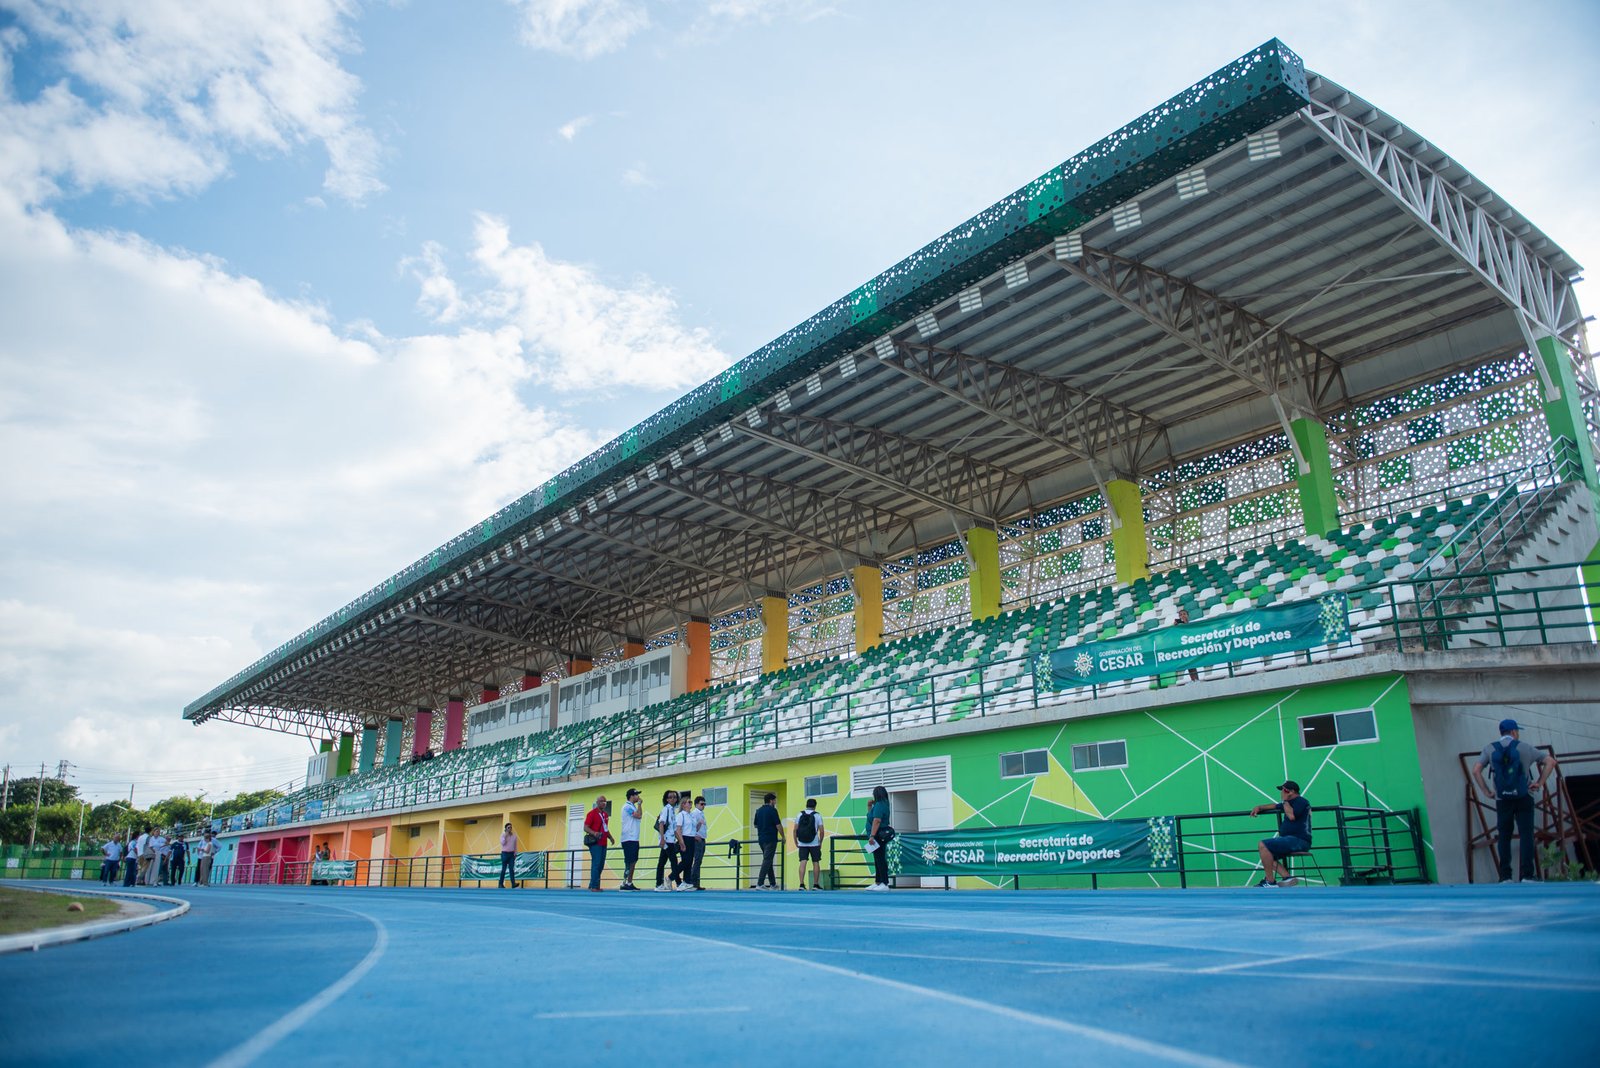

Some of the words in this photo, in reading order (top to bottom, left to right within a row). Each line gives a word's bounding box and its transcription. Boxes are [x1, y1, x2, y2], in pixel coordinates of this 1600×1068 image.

[1180, 623, 1243, 645] Secretaría
[1244, 621, 1261, 633] de
[1157, 642, 1222, 662] Recreación
[1222, 640, 1232, 654] y
[1233, 630, 1292, 648] Deportes
[1099, 652, 1145, 672] CESAR
[1019, 834, 1078, 848] Secretaría
[1078, 834, 1094, 845] de
[944, 849, 985, 864] CESAR
[997, 849, 1057, 863] Recreación
[1057, 851, 1067, 865] y
[1067, 848, 1121, 864] Deportes
